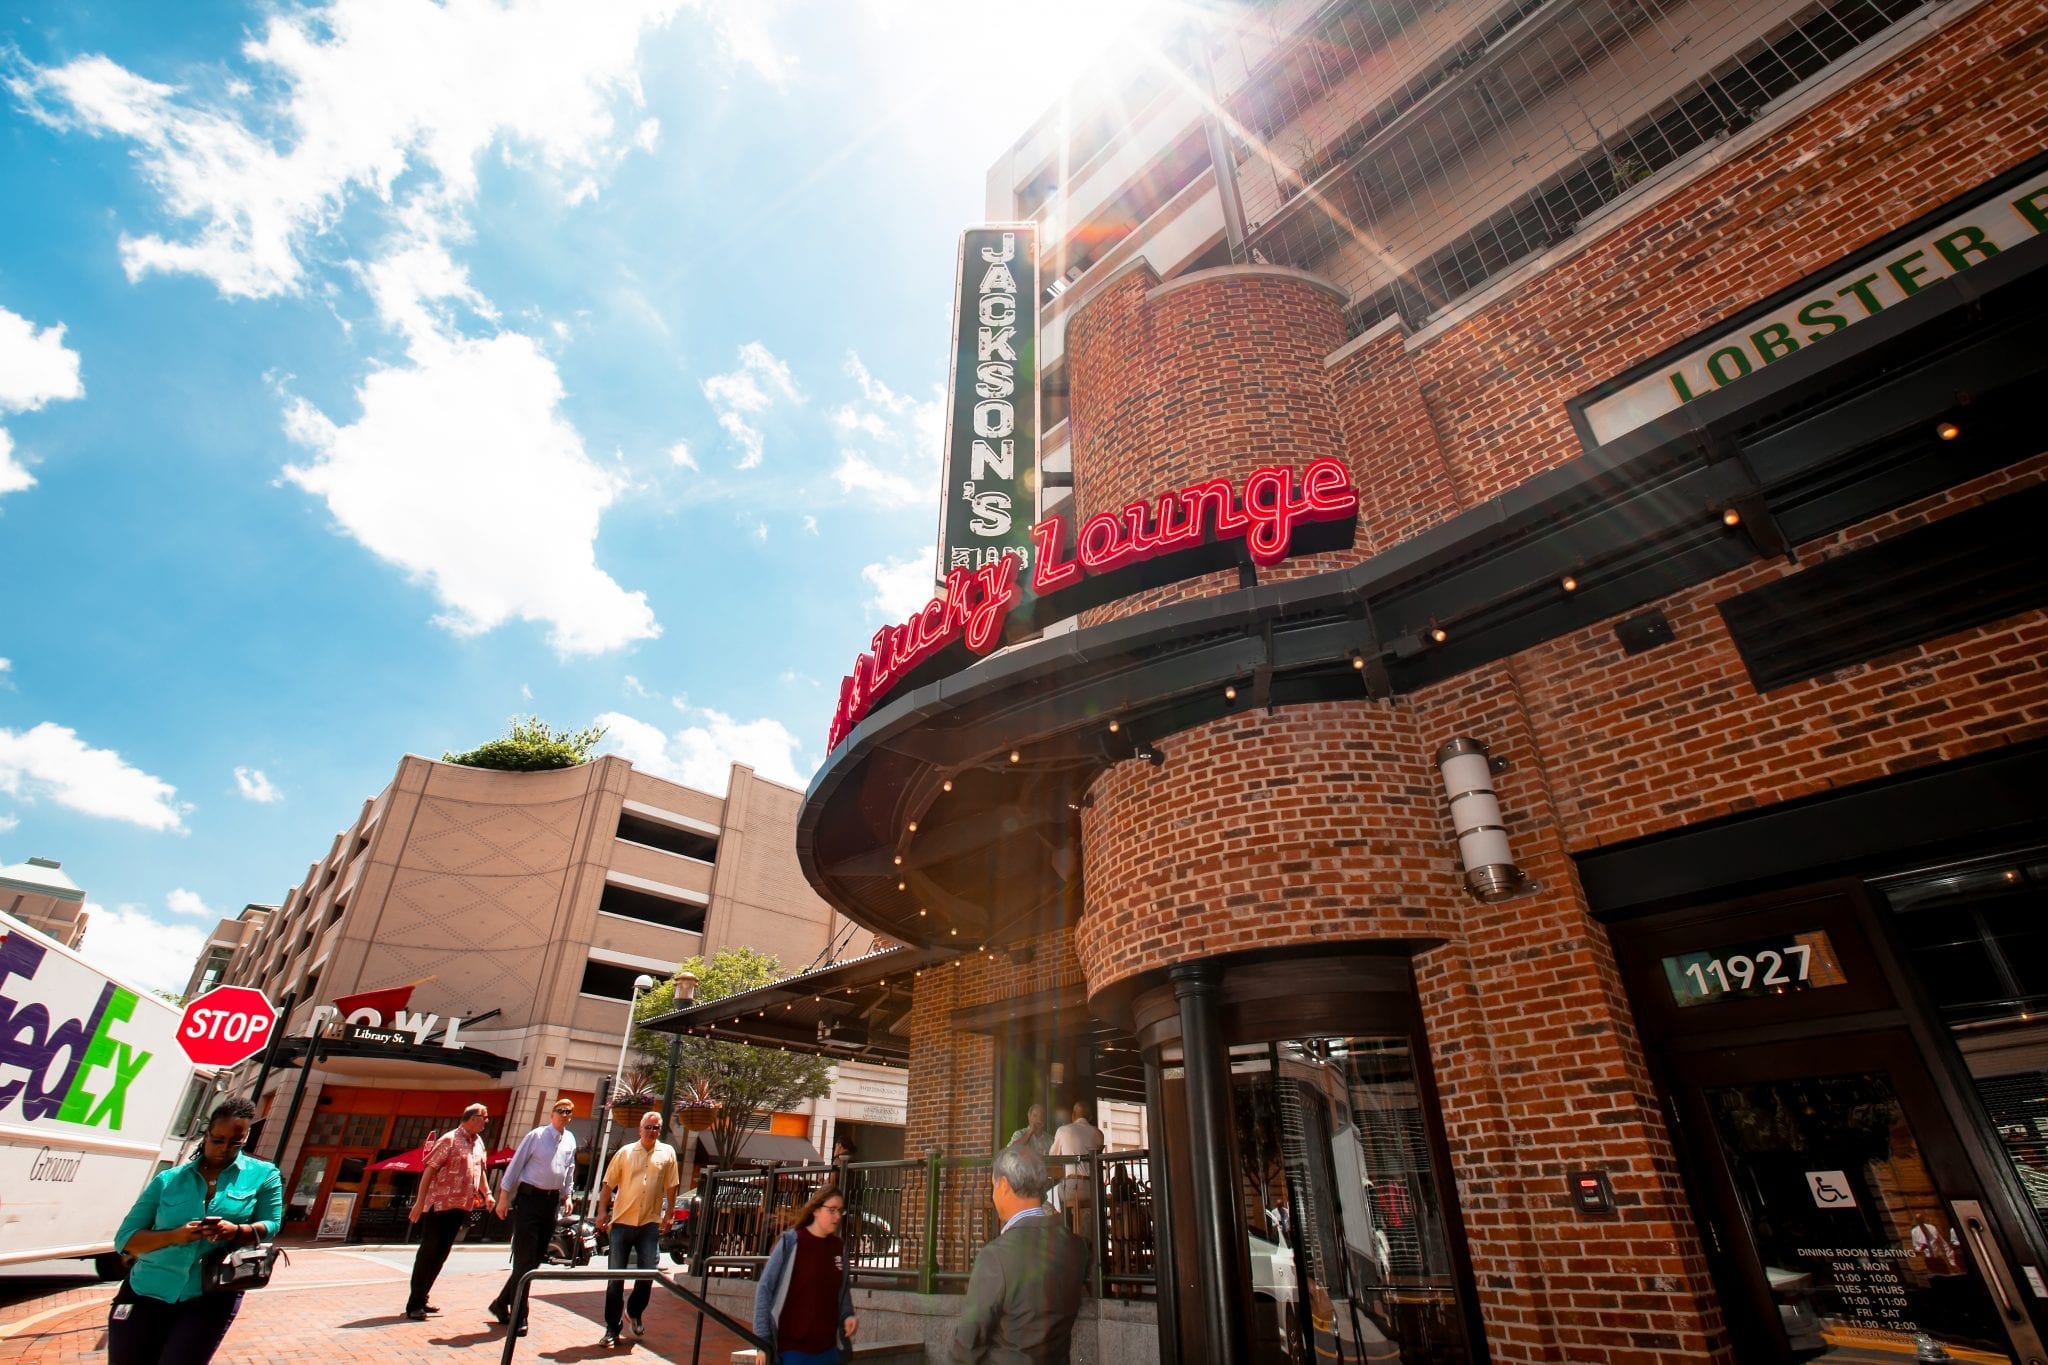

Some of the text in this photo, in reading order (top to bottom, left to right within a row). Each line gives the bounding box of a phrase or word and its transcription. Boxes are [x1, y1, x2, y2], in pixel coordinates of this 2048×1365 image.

[1668, 226, 2000, 403] LOBSTER
[963, 233, 1017, 536] JACKSON'S
[867, 553, 1018, 694] Lucky
[1032, 458, 1358, 588] Lounge
[1686, 944, 1811, 994] 11927
[186, 1008, 269, 1043] STOP
[354, 1028, 405, 1043] Library St.
[29, 1146, 86, 1183] Ground
[1797, 1248, 1917, 1258] DINING ROOM SEATING
[1832, 1262, 1854, 1271] SUN
[1863, 1263, 1890, 1271] MON
[1834, 1274, 1861, 1282] 11:00
[1870, 1274, 1898, 1283] 10:00
[1835, 1285, 1862, 1294] TUES
[1870, 1285, 1905, 1295] THURS
[1842, 1297, 1870, 1305] 11:00
[1879, 1297, 1907, 1306] 11:00
[1856, 1308, 1873, 1317] FRI
[1881, 1309, 1900, 1318] SAT
[1851, 1320, 1879, 1329] 11:00
[1887, 1321, 1917, 1330] 12:00
